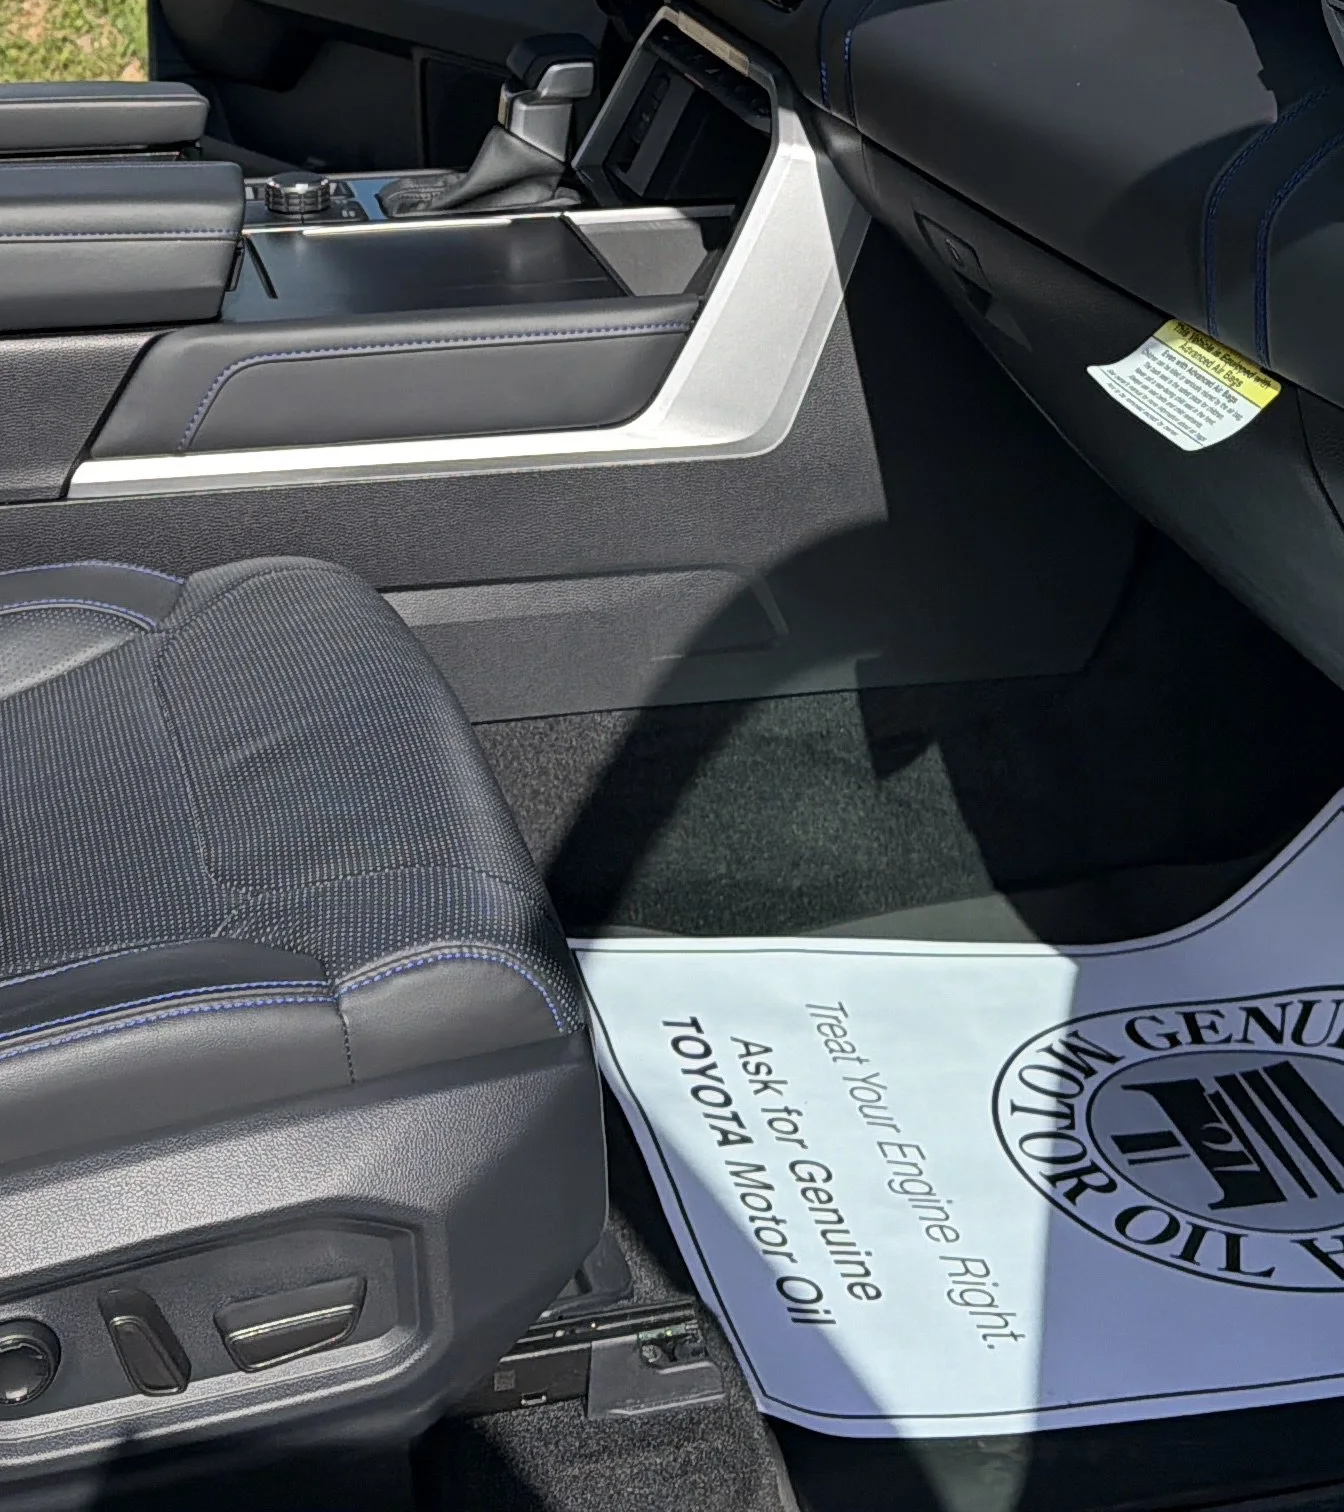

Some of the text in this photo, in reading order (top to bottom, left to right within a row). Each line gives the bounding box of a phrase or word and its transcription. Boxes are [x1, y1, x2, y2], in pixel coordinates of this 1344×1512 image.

[1174, 323, 1189, 337] This
[1219, 354, 1255, 380] Equipped
[1179, 342, 1243, 388] Advanced Air Bags
[1186, 367, 1214, 387] Advanced
[1213, 384, 1223, 392] Air
[661, 1015, 837, 1326] TOYOTA Motor Oil
[729, 1036, 883, 1302] Ask for Genuine
[804, 1001, 1027, 1350] Treat Your Engine Right.
[1009, 1029, 1127, 1208] MOTOR
[1113, 1204, 1277, 1280] OIL
